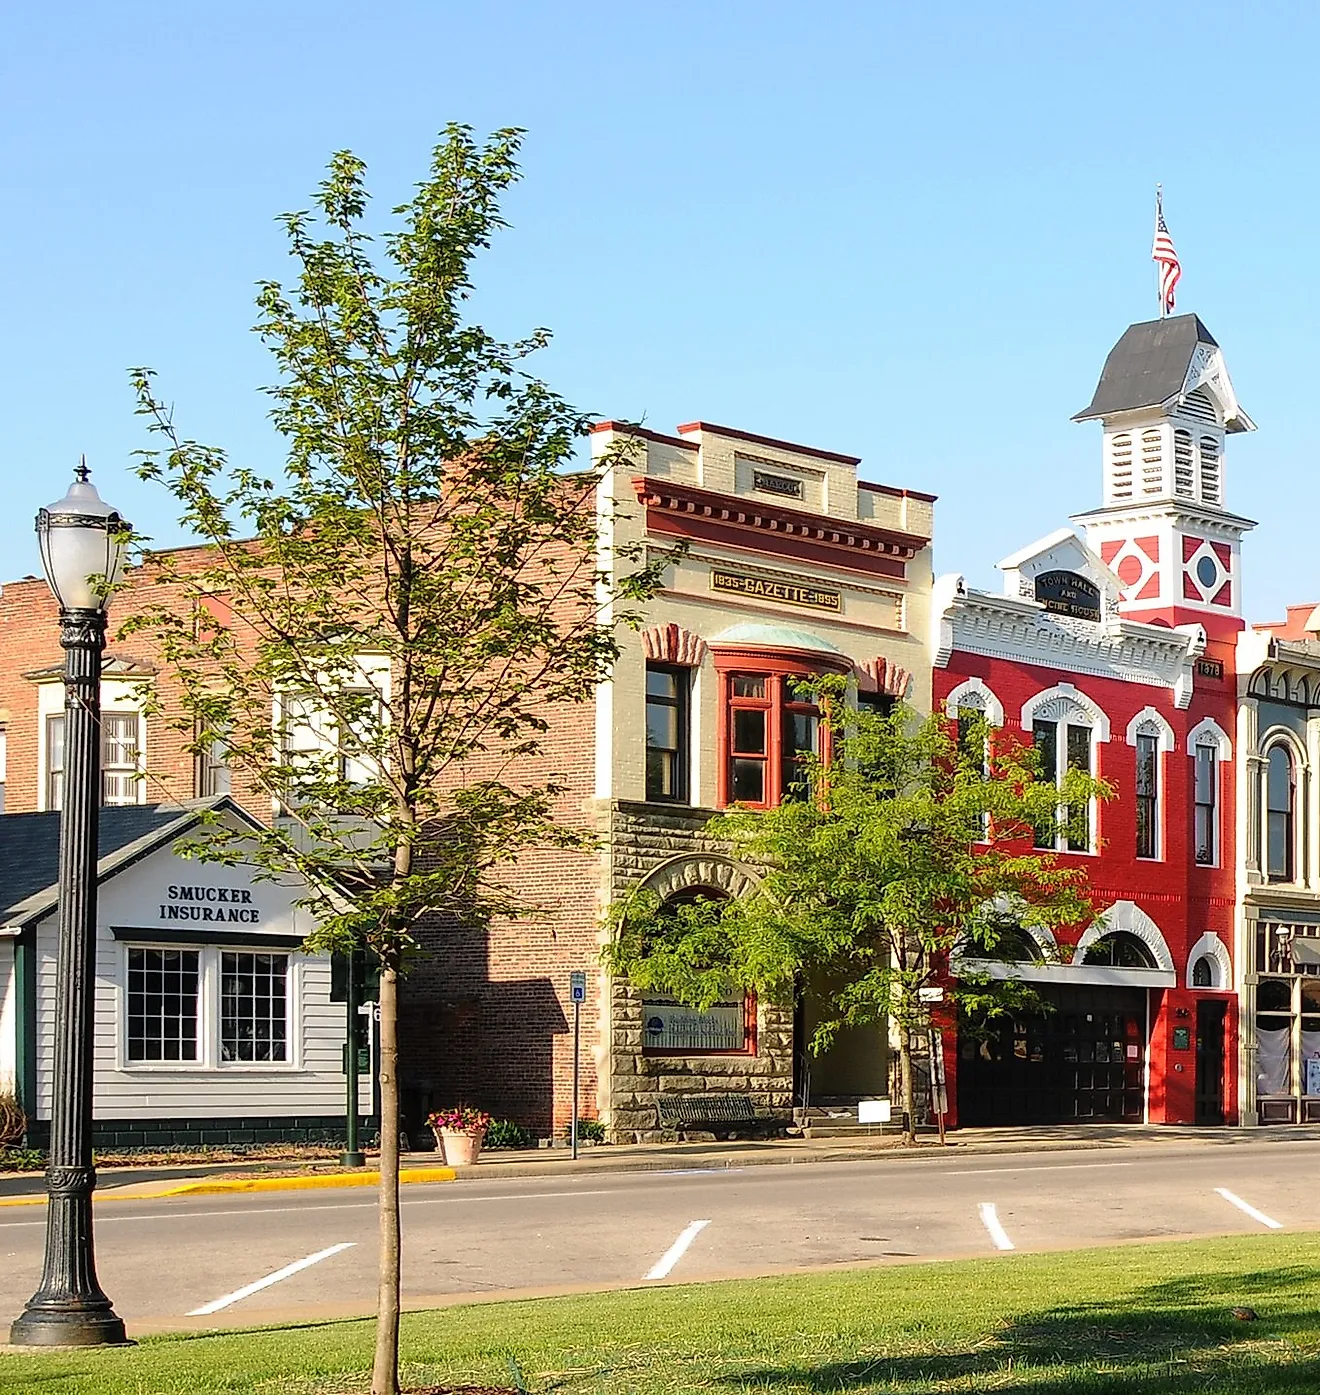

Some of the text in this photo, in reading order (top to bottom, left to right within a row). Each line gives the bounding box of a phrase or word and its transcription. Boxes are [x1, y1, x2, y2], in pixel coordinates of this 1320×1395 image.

[1041, 576, 1095, 597] TOWN HALL
[167, 885, 253, 904] SMUCKER
[159, 904, 260, 923] INSURANCE
